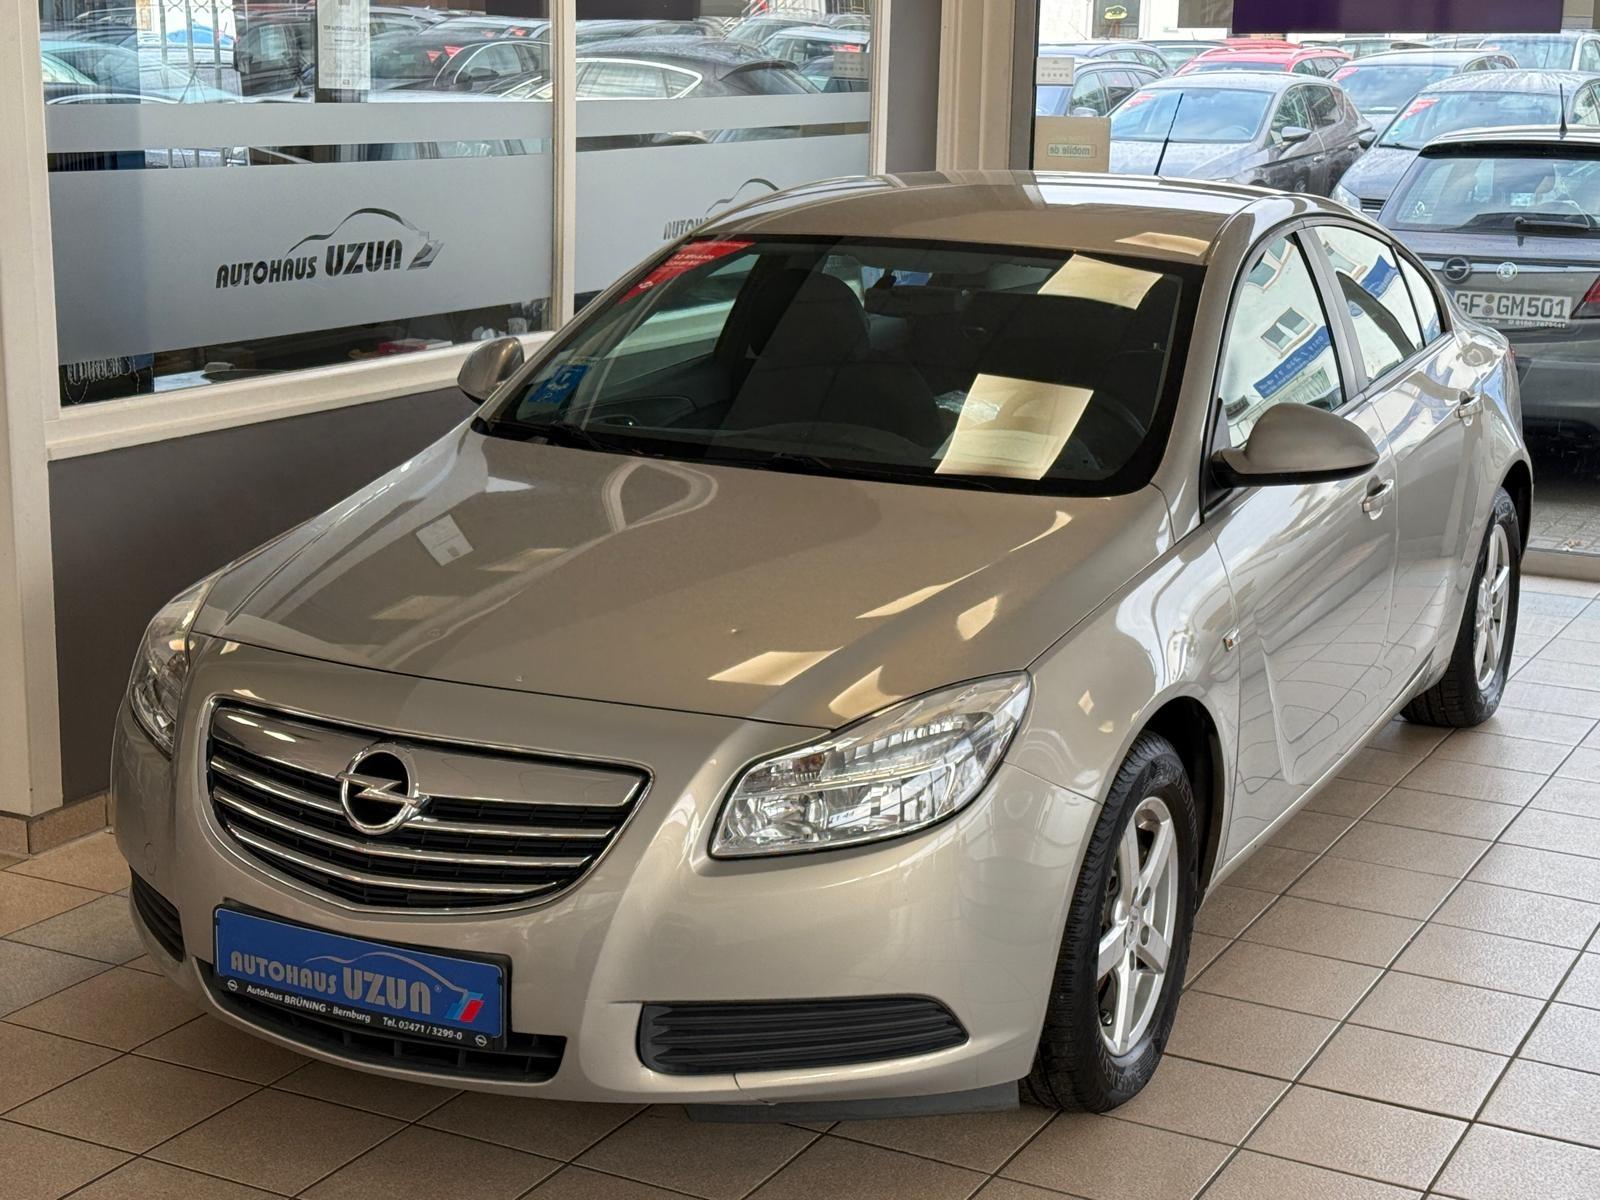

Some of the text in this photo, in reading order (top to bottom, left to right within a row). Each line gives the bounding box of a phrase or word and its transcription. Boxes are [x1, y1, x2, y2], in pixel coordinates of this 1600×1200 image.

[215, 238, 403, 289] AUTOHAUS UZUN
[1456, 293, 1482, 314] GF
[230, 950, 431, 1015] AUTOHAUS UZUN
[247, 984, 283, 1002] Autohaus
[284, 994, 326, 1013] BRÜNING
[333, 1005, 371, 1024] Bernburg
[382, 1016, 397, 1028] Tel.
[398, 1020, 424, 1033] 03471
[431, 1026, 463, 1040] 3299-0
